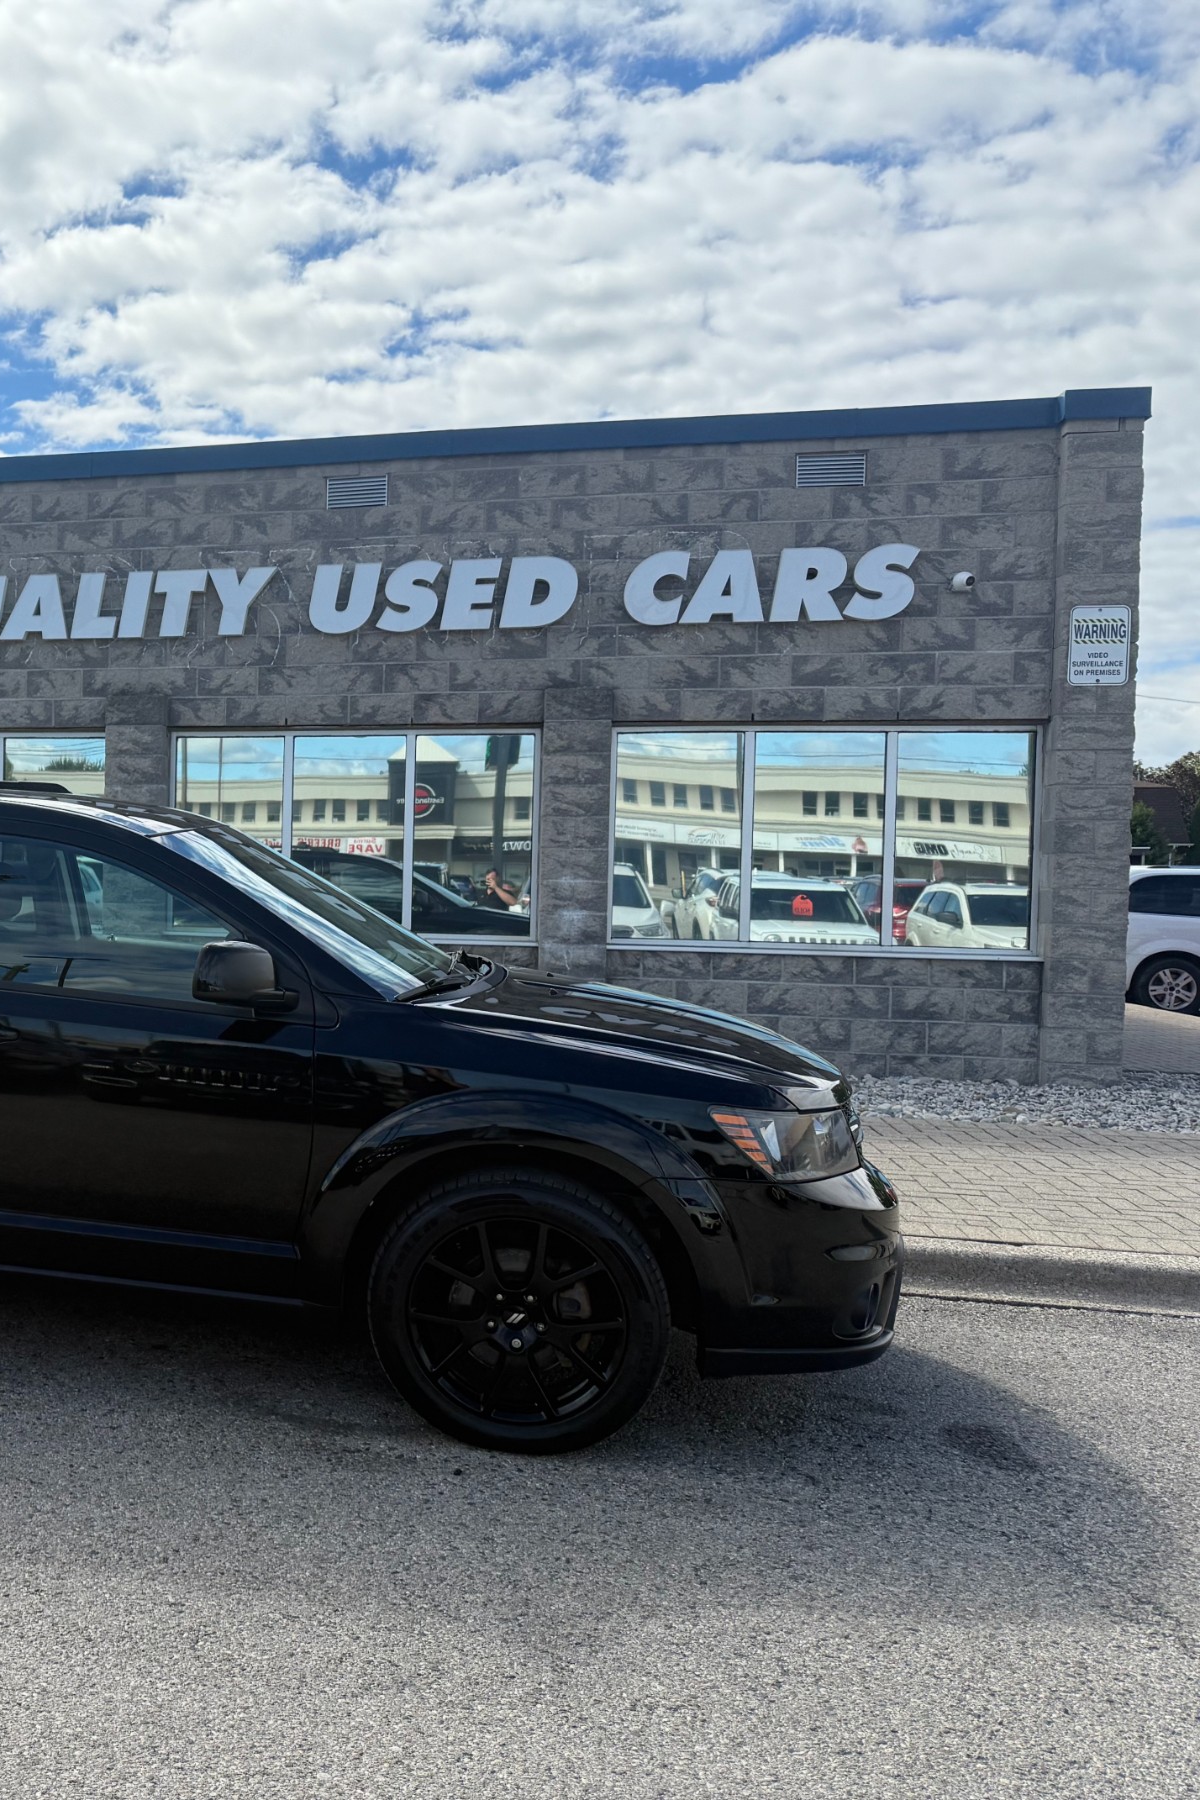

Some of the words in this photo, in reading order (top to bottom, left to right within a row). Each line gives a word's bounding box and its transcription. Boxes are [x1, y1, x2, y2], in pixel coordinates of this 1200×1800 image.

[308, 556, 579, 635] USED
[623, 543, 921, 627] CARS
[1073, 623, 1127, 639] WARNING
[1071, 660, 1124, 668] SURVEILLANCE
